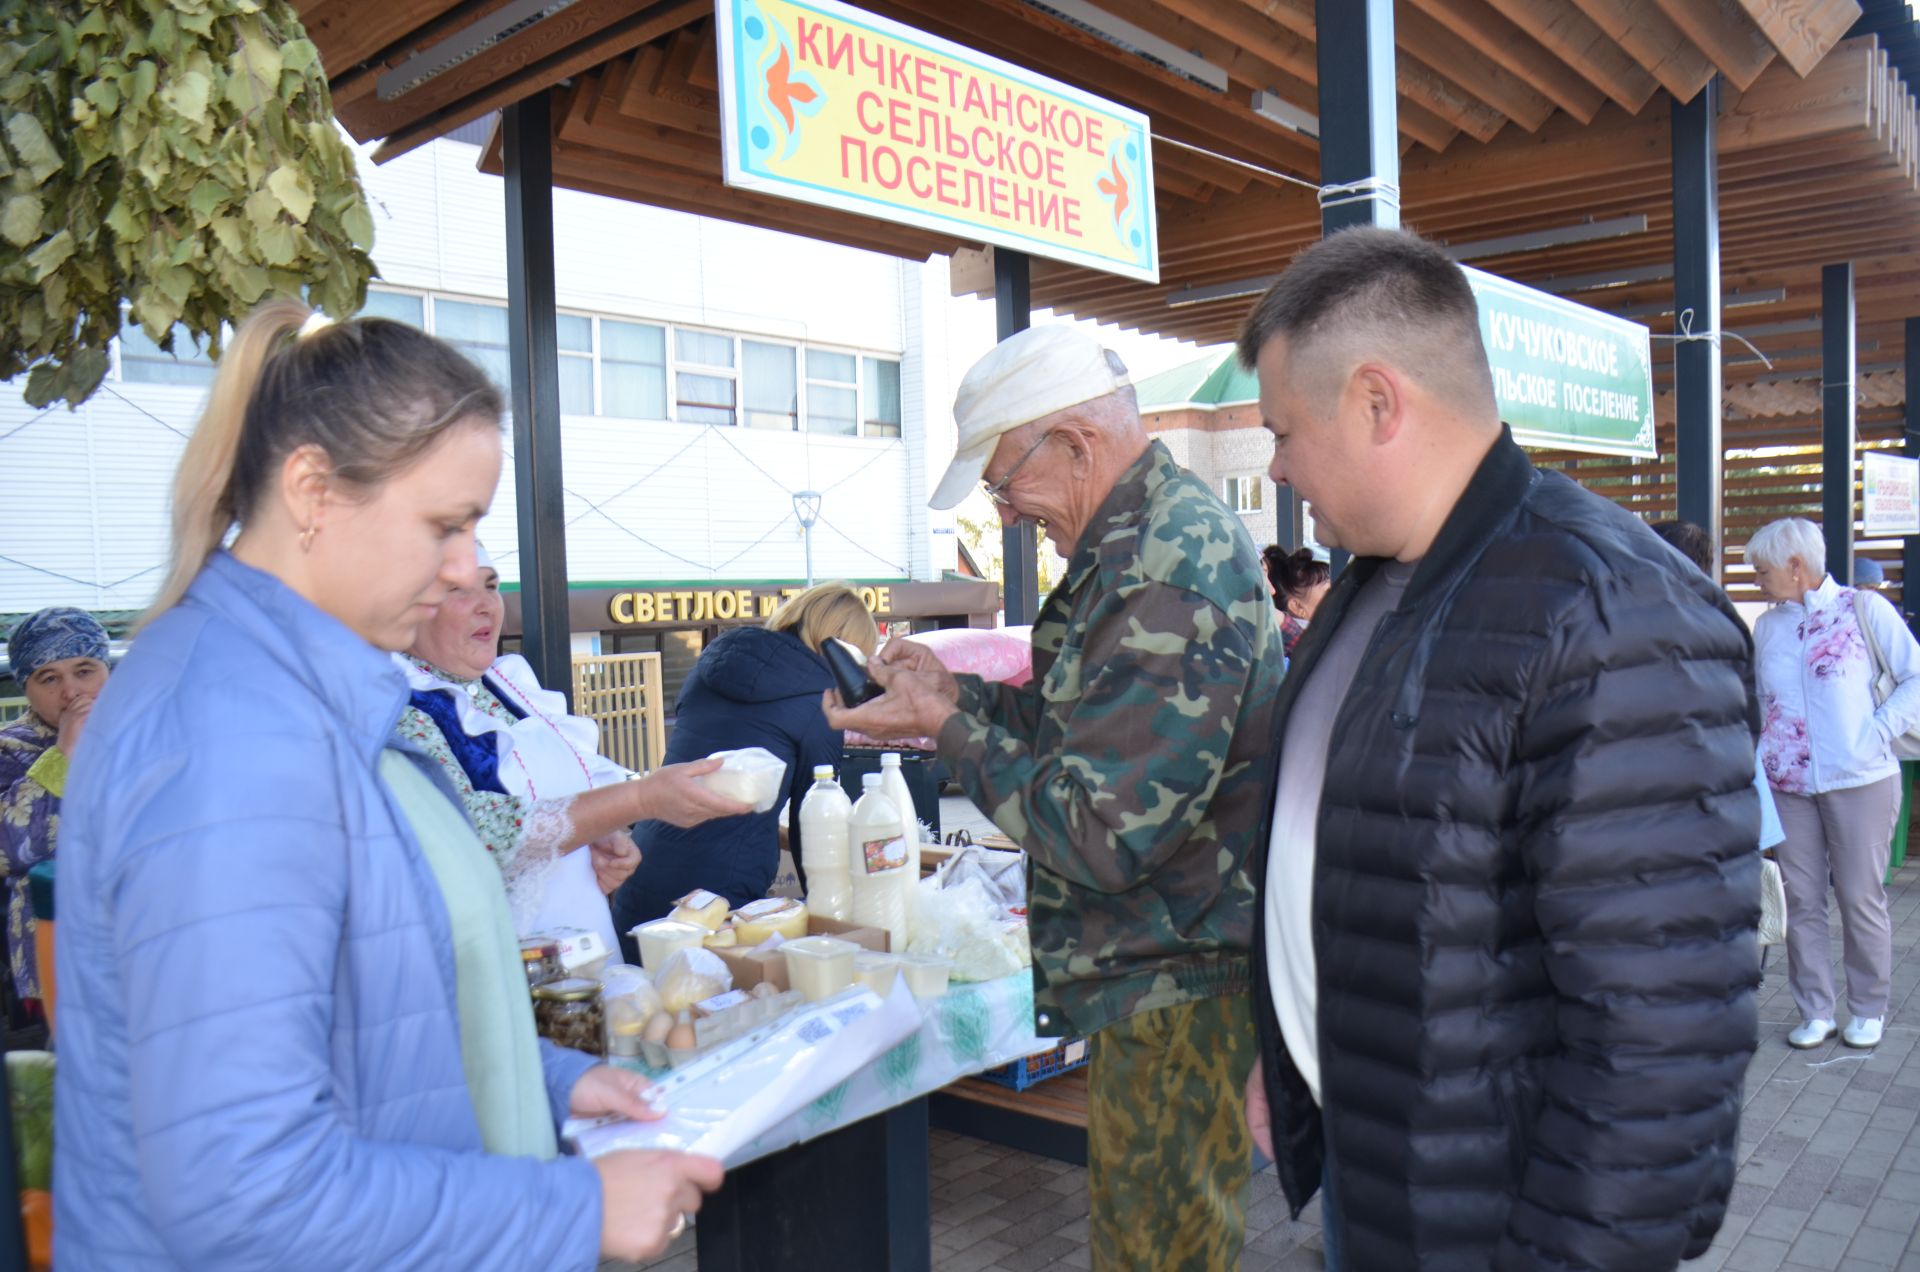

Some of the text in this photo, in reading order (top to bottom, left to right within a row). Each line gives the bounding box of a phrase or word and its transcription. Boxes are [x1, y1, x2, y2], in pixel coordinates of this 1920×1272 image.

[797, 16, 1105, 158] КИЧКЕТАНСКОЕ
[856, 91, 1067, 189] СЕЛЬСКОЕ
[840, 135, 1083, 238] ПОСЕЛЕНИЕ
[1489, 309, 1619, 377] КУЧУКОВСКОЕ
[1490, 366, 1640, 422] ЛЬСКОЕ ПОСЕЛЕНИЕ
[611, 591, 753, 623] СВЕТЛОЕ
